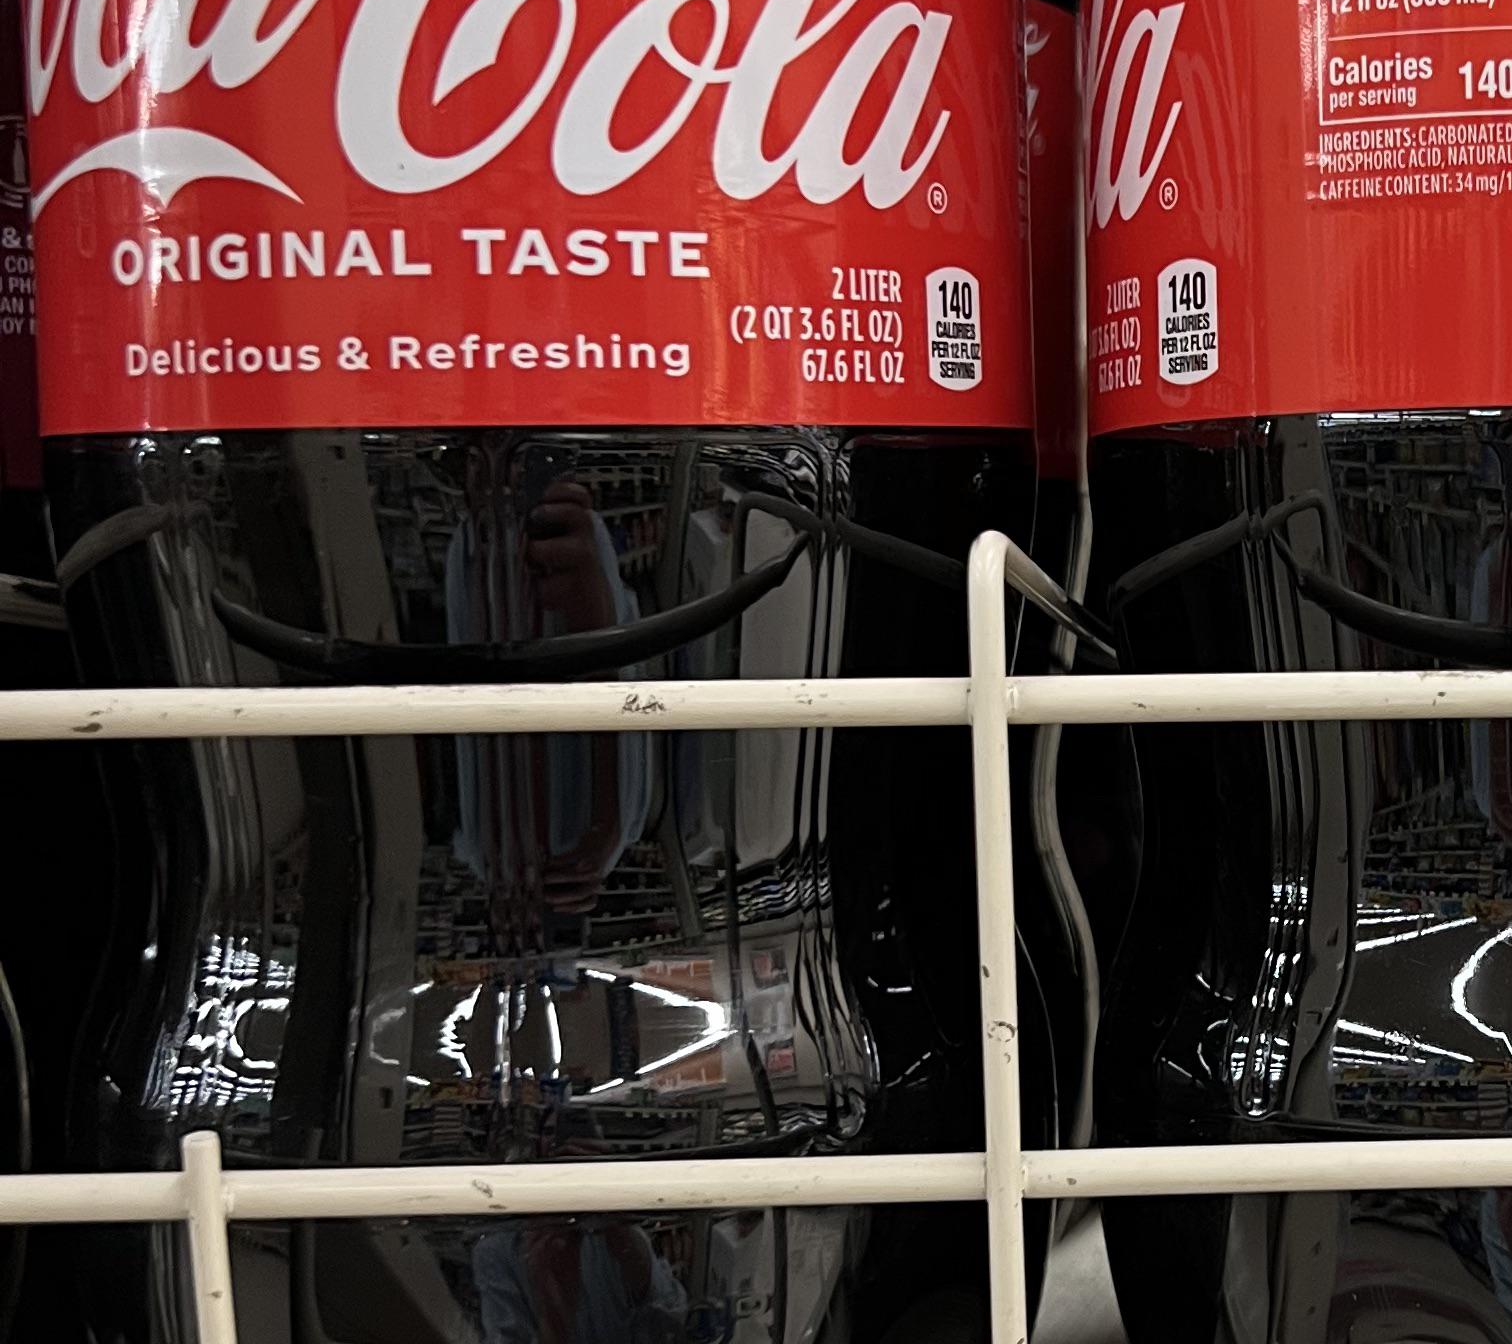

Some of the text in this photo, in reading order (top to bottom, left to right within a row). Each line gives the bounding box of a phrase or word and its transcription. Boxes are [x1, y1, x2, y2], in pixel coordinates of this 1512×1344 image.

[1329, 52, 1434, 86] Calories
[1329, 85, 1417, 113] per serving
[1319, 127, 1417, 154] INGREDIENTS:
[1319, 149, 1406, 175] PHOSPHORIC
[1409, 147, 1447, 170] ACID,
[1319, 172, 1453, 201] CAFFEINE CONTENT:
[113, 229, 712, 287] ORIGINAL TASTE
[832, 267, 902, 303] 2 LITER
[938, 280, 973, 320] 140
[1113, 277, 1142, 313] LITER
[1168, 271, 1207, 313] 140
[730, 305, 903, 348] (2 QT 3.6 FL OZ)
[126, 333, 691, 377] Delicious & Refreshing
[802, 348, 905, 384] 67.6 FL OZ
